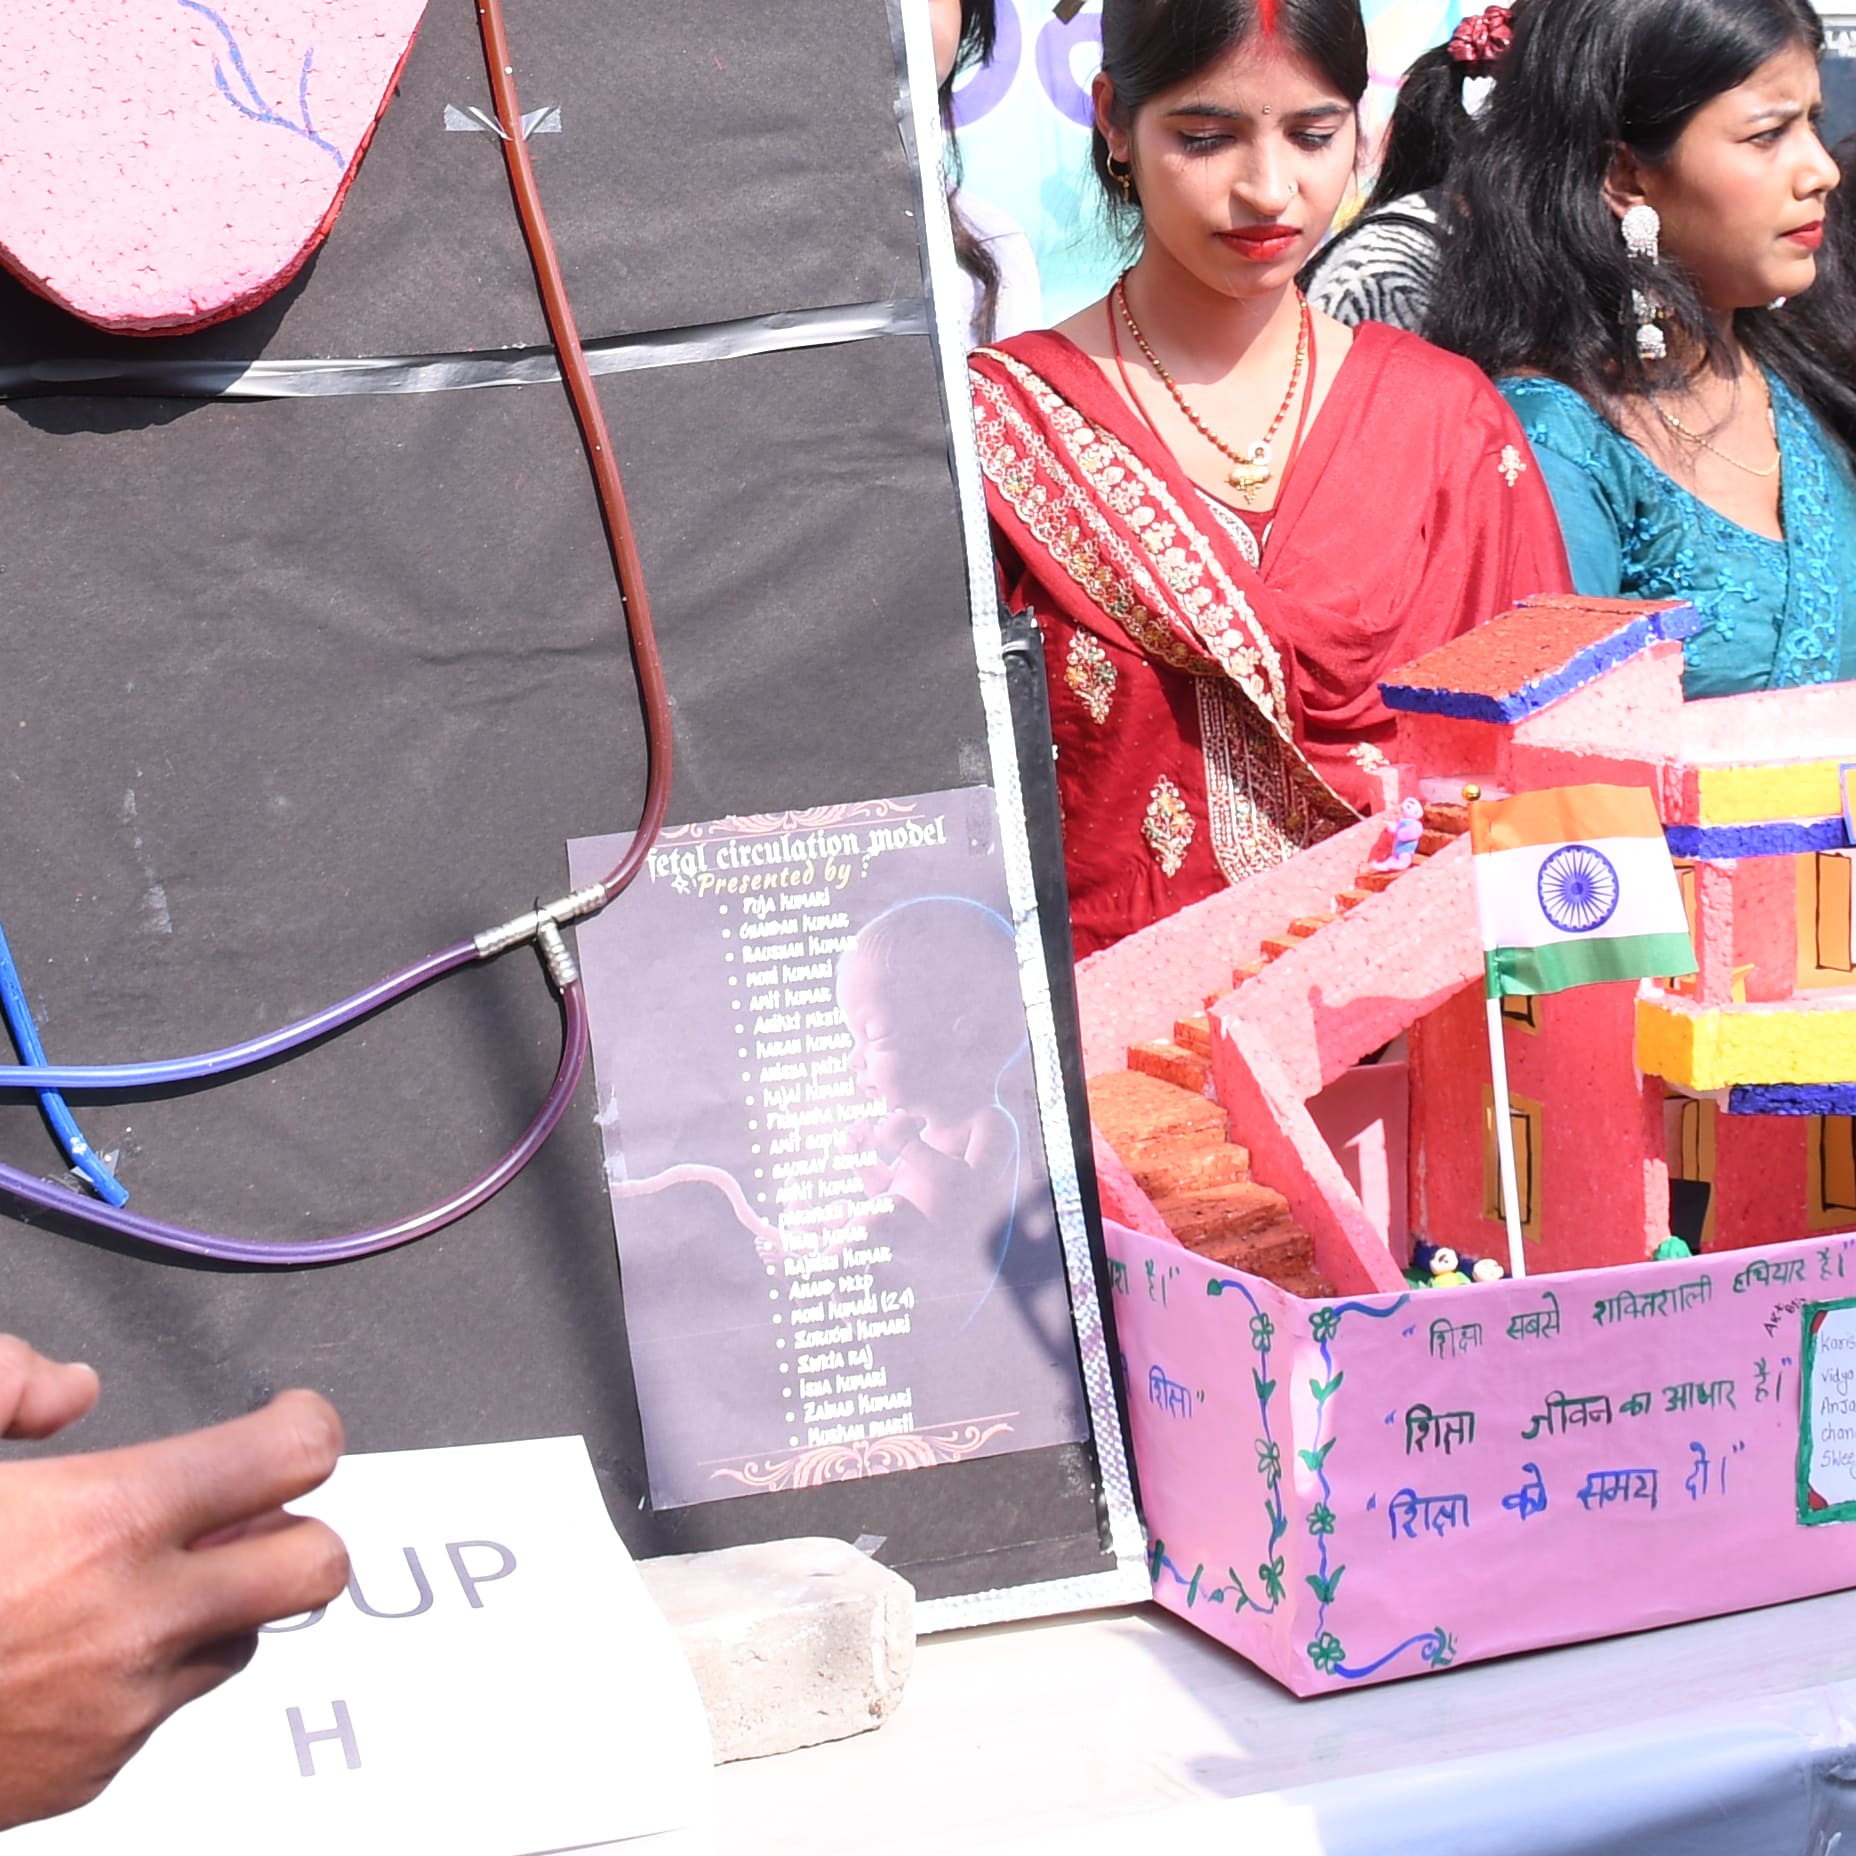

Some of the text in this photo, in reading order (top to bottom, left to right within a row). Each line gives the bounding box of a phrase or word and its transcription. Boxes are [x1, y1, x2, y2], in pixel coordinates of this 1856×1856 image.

[716, 831, 860, 871] circulation
[867, 815, 947, 857] model
[1506, 1293, 1560, 1341] सबसे
[1501, 1462, 1548, 1521] को
[1577, 1468, 1659, 1511] समय
[286, 1699, 362, 1776] H
